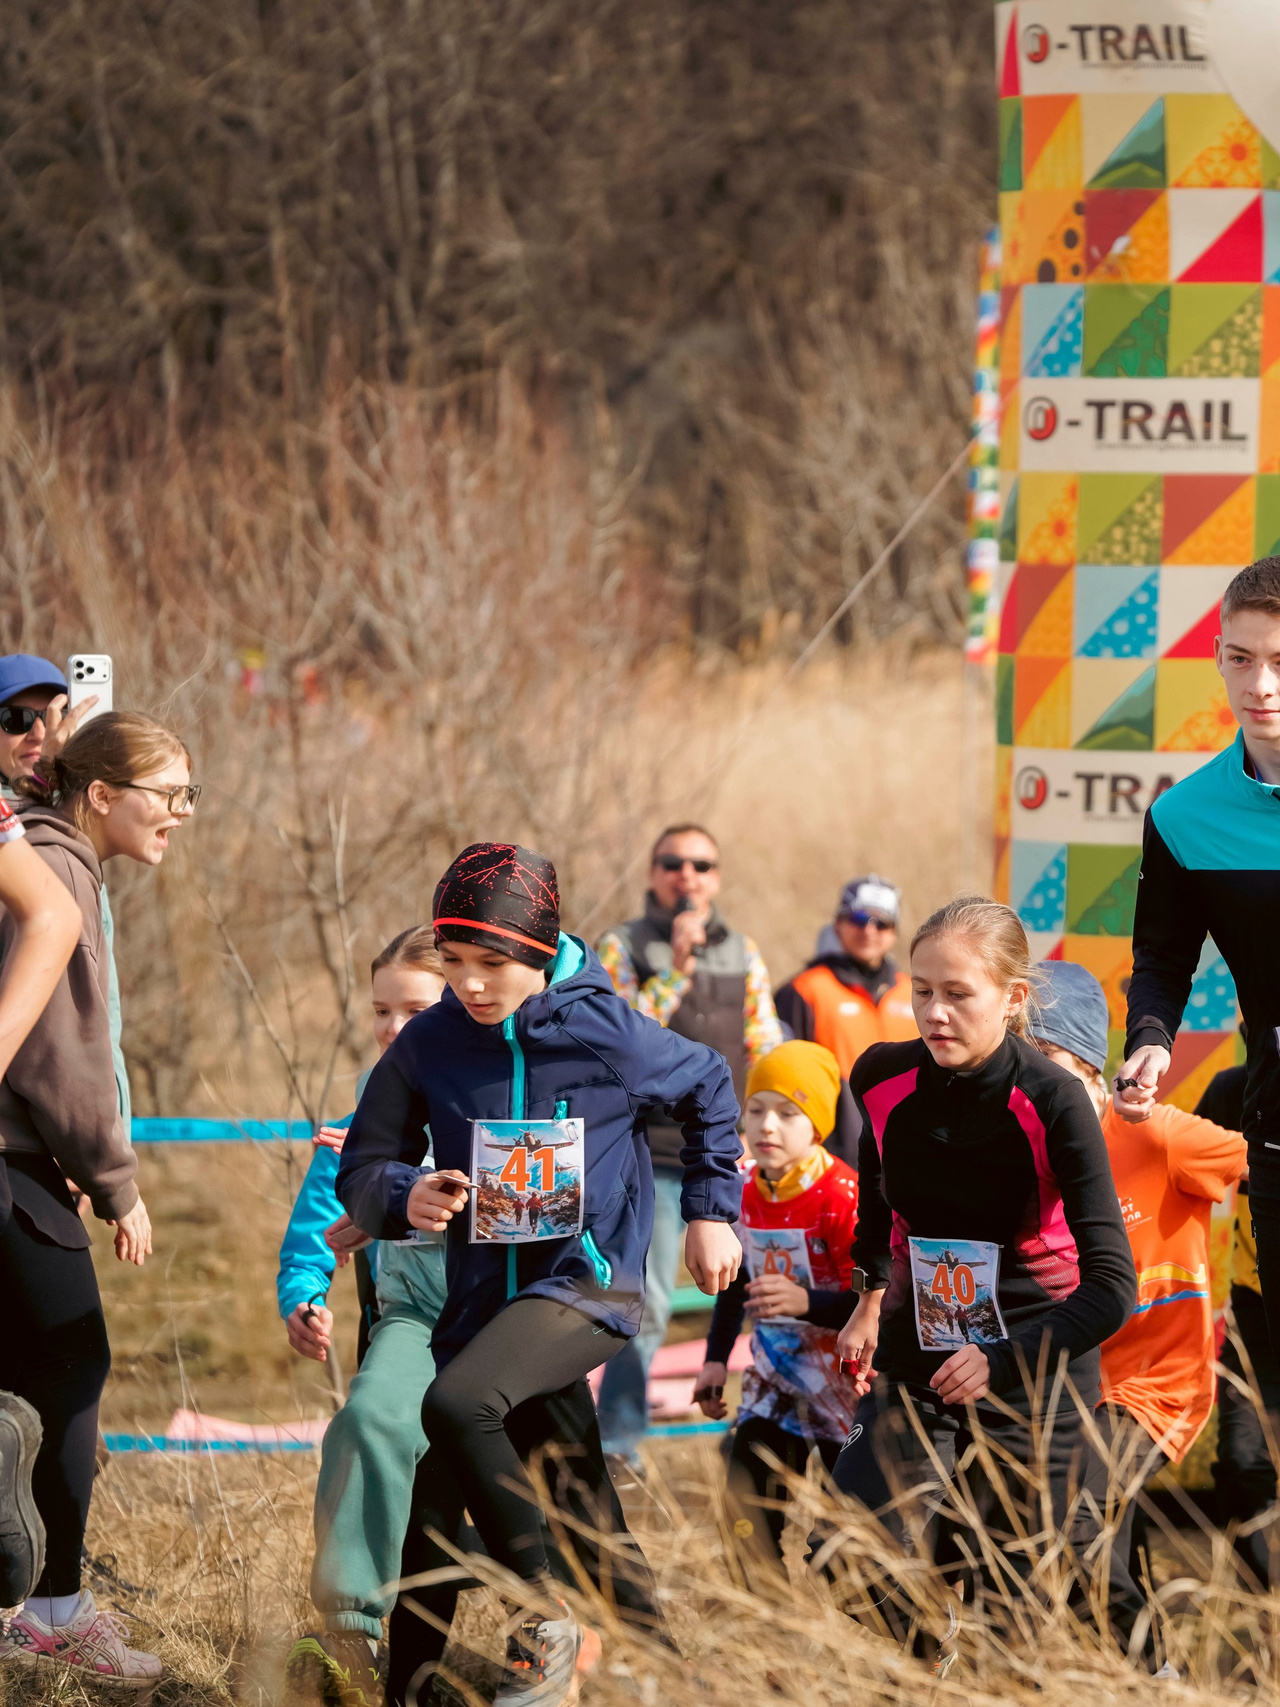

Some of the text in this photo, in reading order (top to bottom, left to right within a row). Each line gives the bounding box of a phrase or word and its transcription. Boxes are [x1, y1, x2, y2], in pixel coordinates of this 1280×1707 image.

[1025, 396, 1247, 441] O-TRAIL
[500, 1146, 556, 1192] 41
[764, 1249, 798, 1281] 42
[932, 1263, 976, 1305] 40
